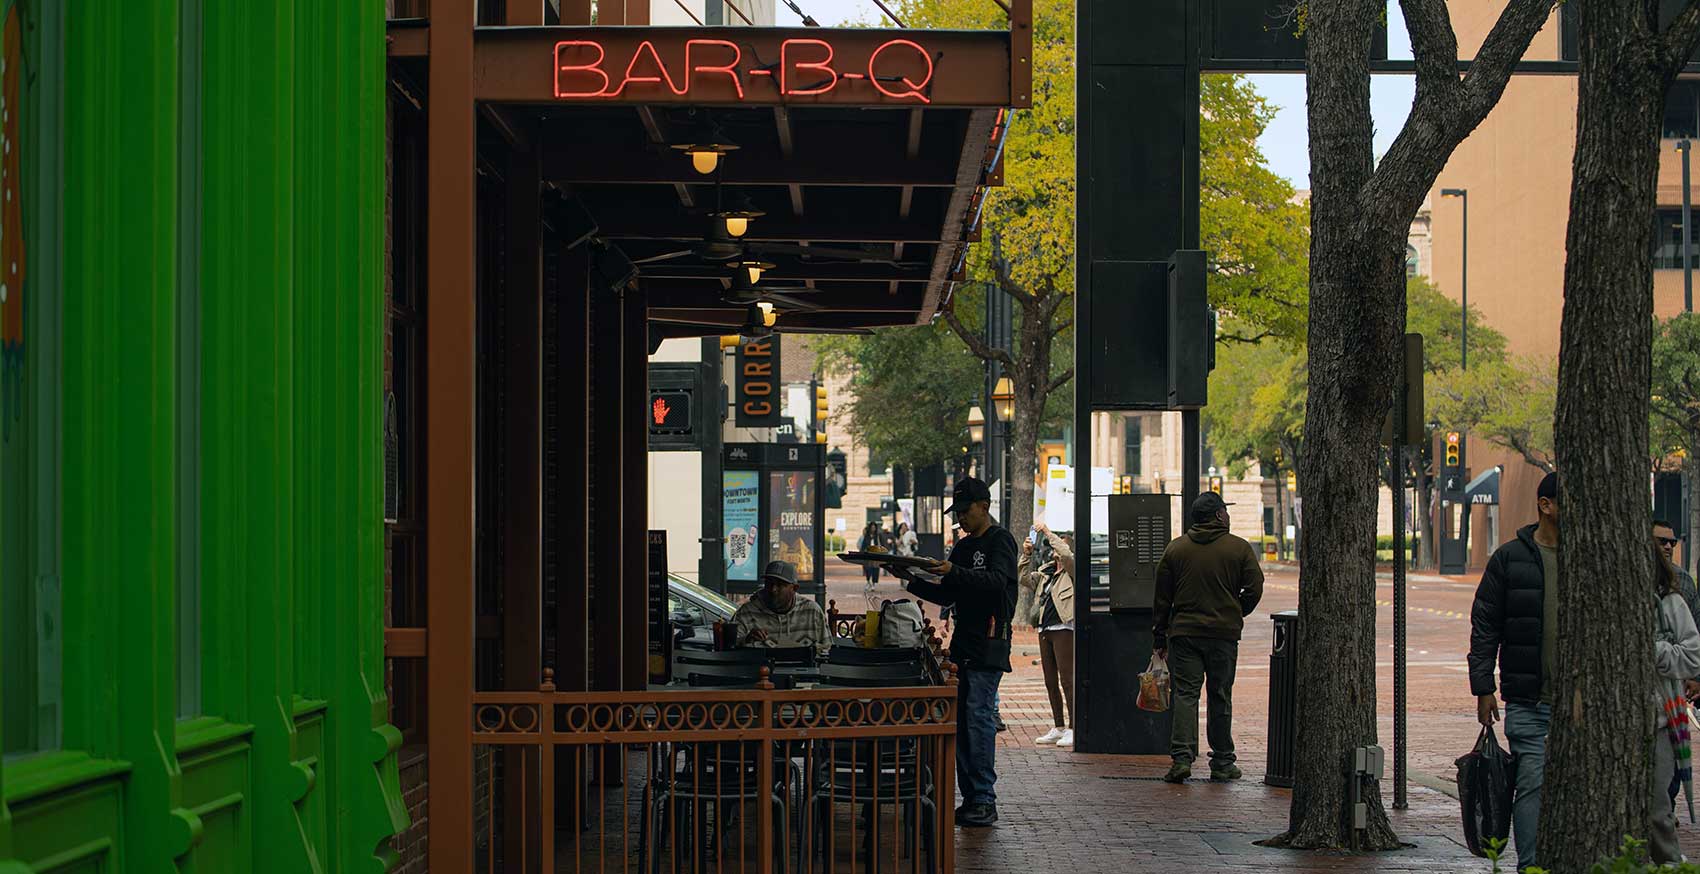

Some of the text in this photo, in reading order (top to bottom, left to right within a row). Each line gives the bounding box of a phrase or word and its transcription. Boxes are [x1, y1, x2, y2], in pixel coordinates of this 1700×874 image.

[554, 38, 932, 103] BAR-B-Q
[1472, 494, 1493, 504] ATM
[781, 512, 812, 526] EXPLORE
